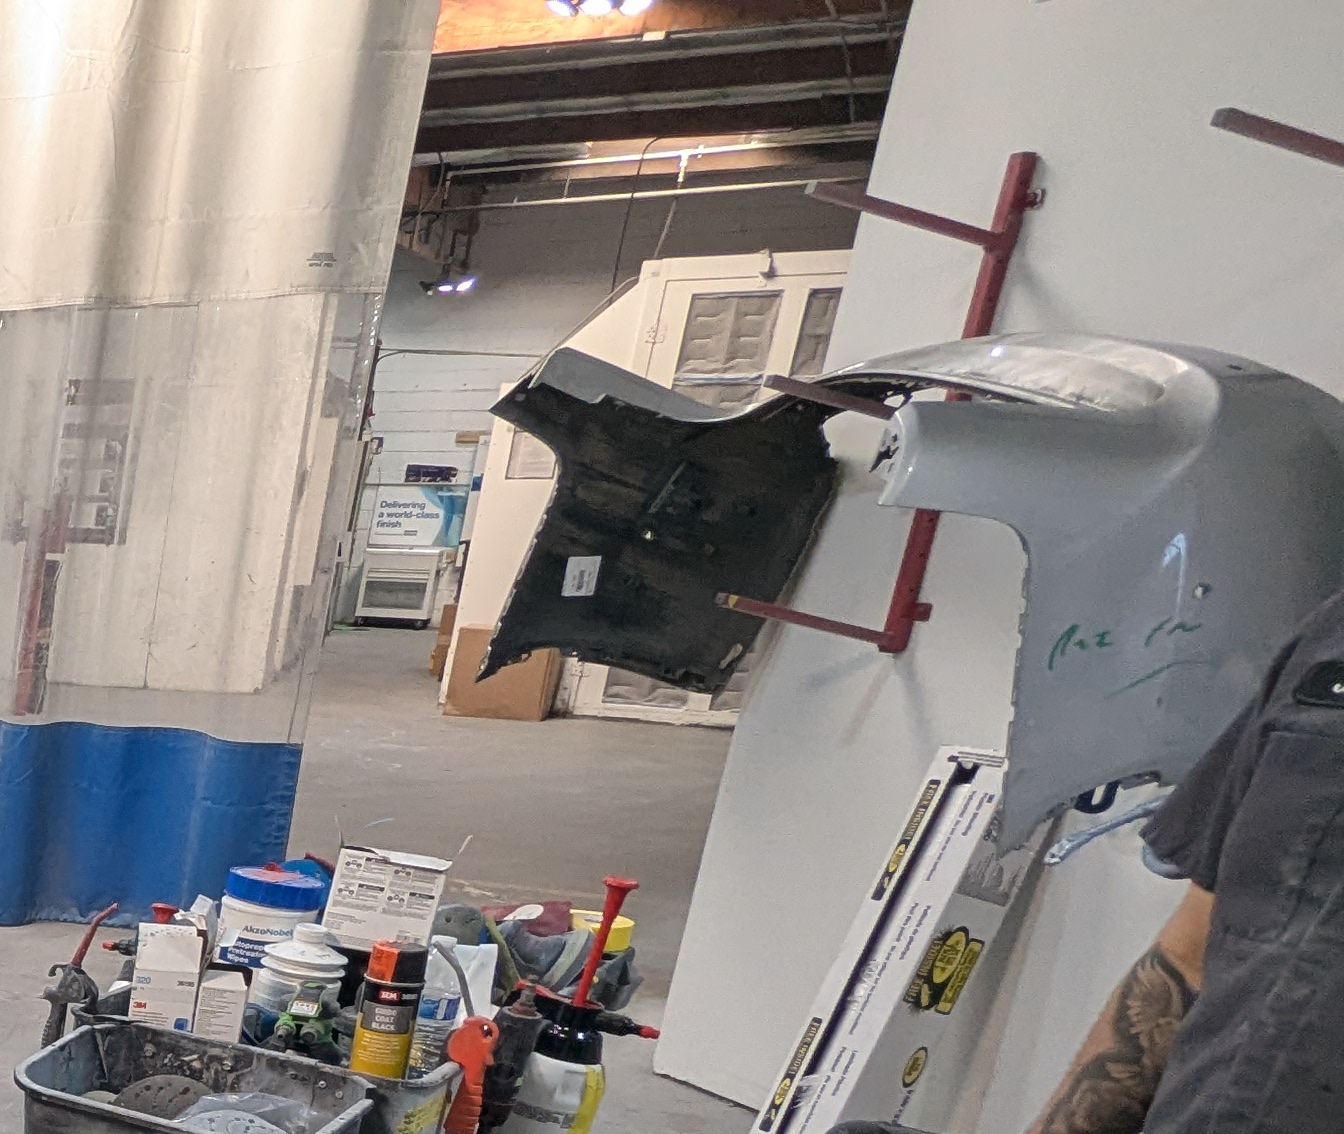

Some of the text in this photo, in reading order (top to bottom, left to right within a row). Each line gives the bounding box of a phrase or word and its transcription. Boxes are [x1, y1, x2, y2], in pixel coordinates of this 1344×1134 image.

[379, 500, 427, 511] Delivering
[378, 510, 440, 520] a world-class
[376, 520, 402, 529] finish
[242, 925, 294, 938] AkzoNobel
[132, 1001, 147, 1010] 3M
[371, 1021, 396, 1032] BLACK
